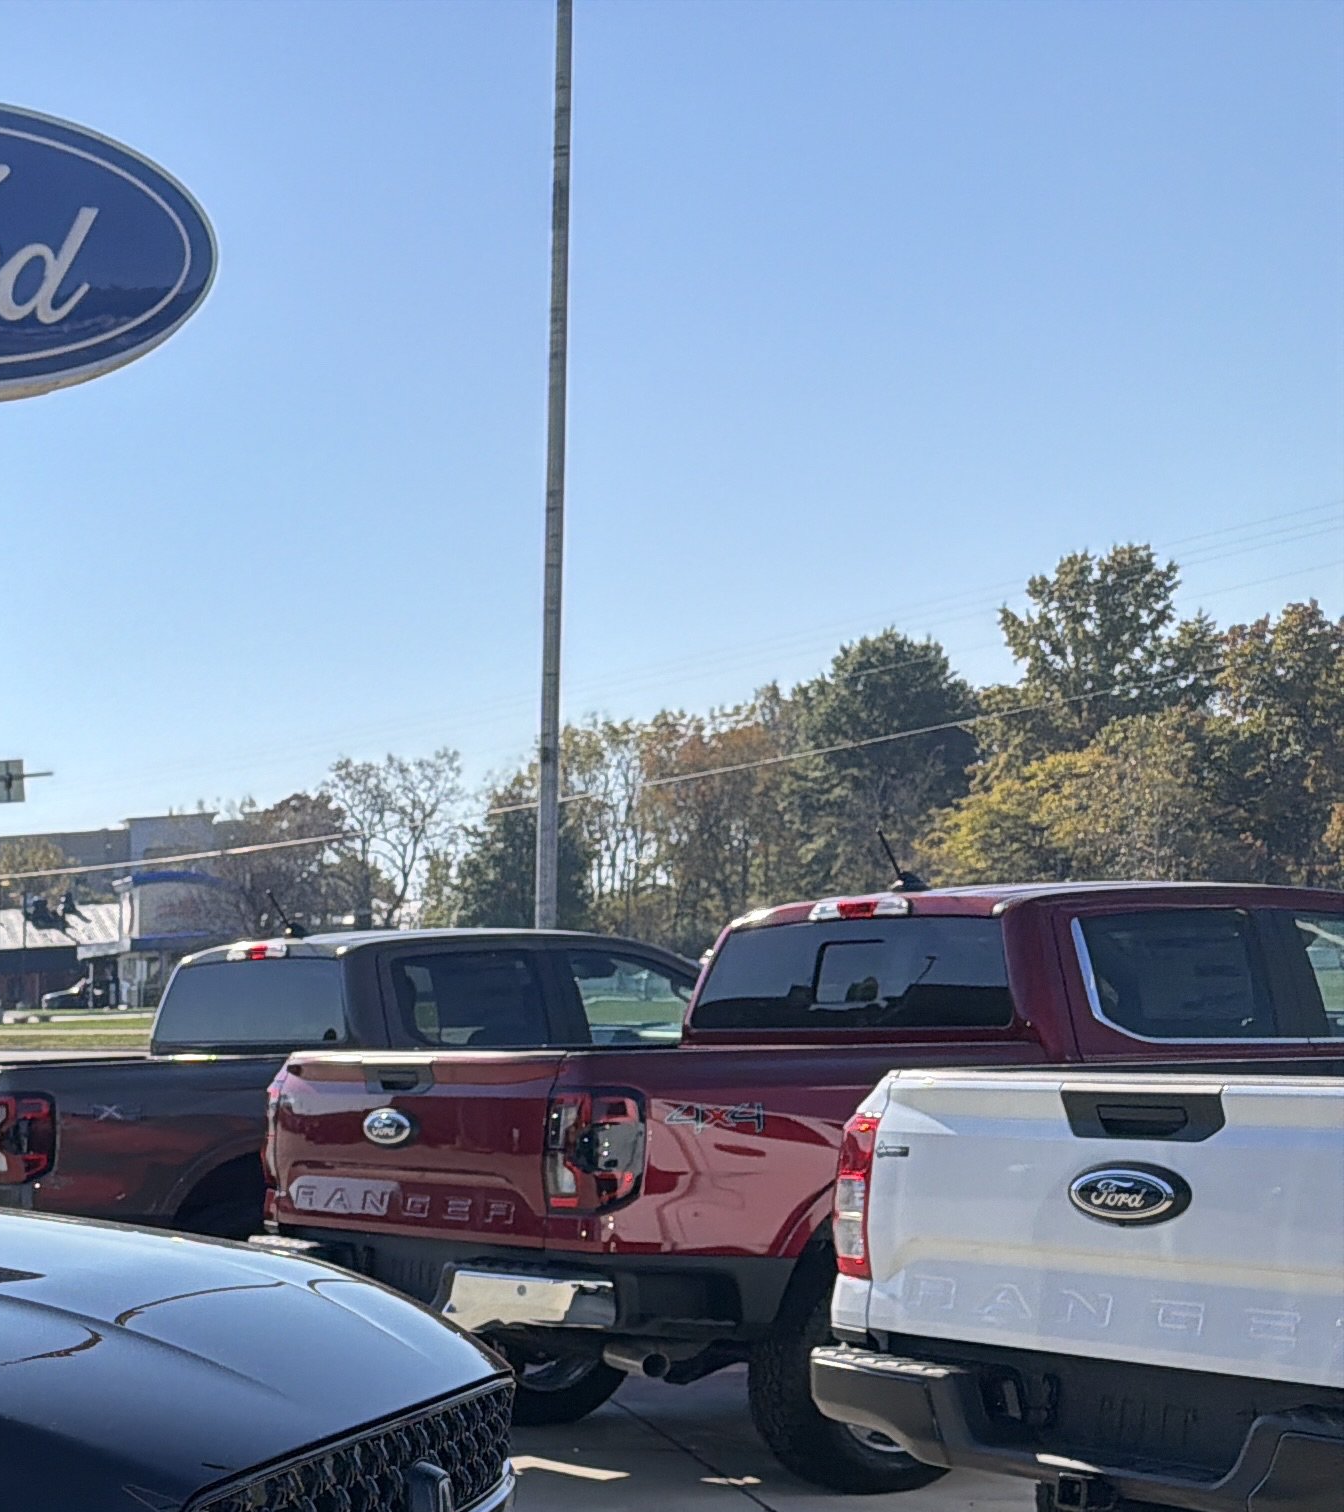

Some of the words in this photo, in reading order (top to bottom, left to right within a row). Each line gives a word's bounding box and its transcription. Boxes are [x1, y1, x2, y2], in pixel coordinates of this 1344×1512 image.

[296, 1184, 516, 1225] RANGER
[1091, 1179, 1146, 1209] Ford
[912, 1273, 1344, 1350] RANGE
